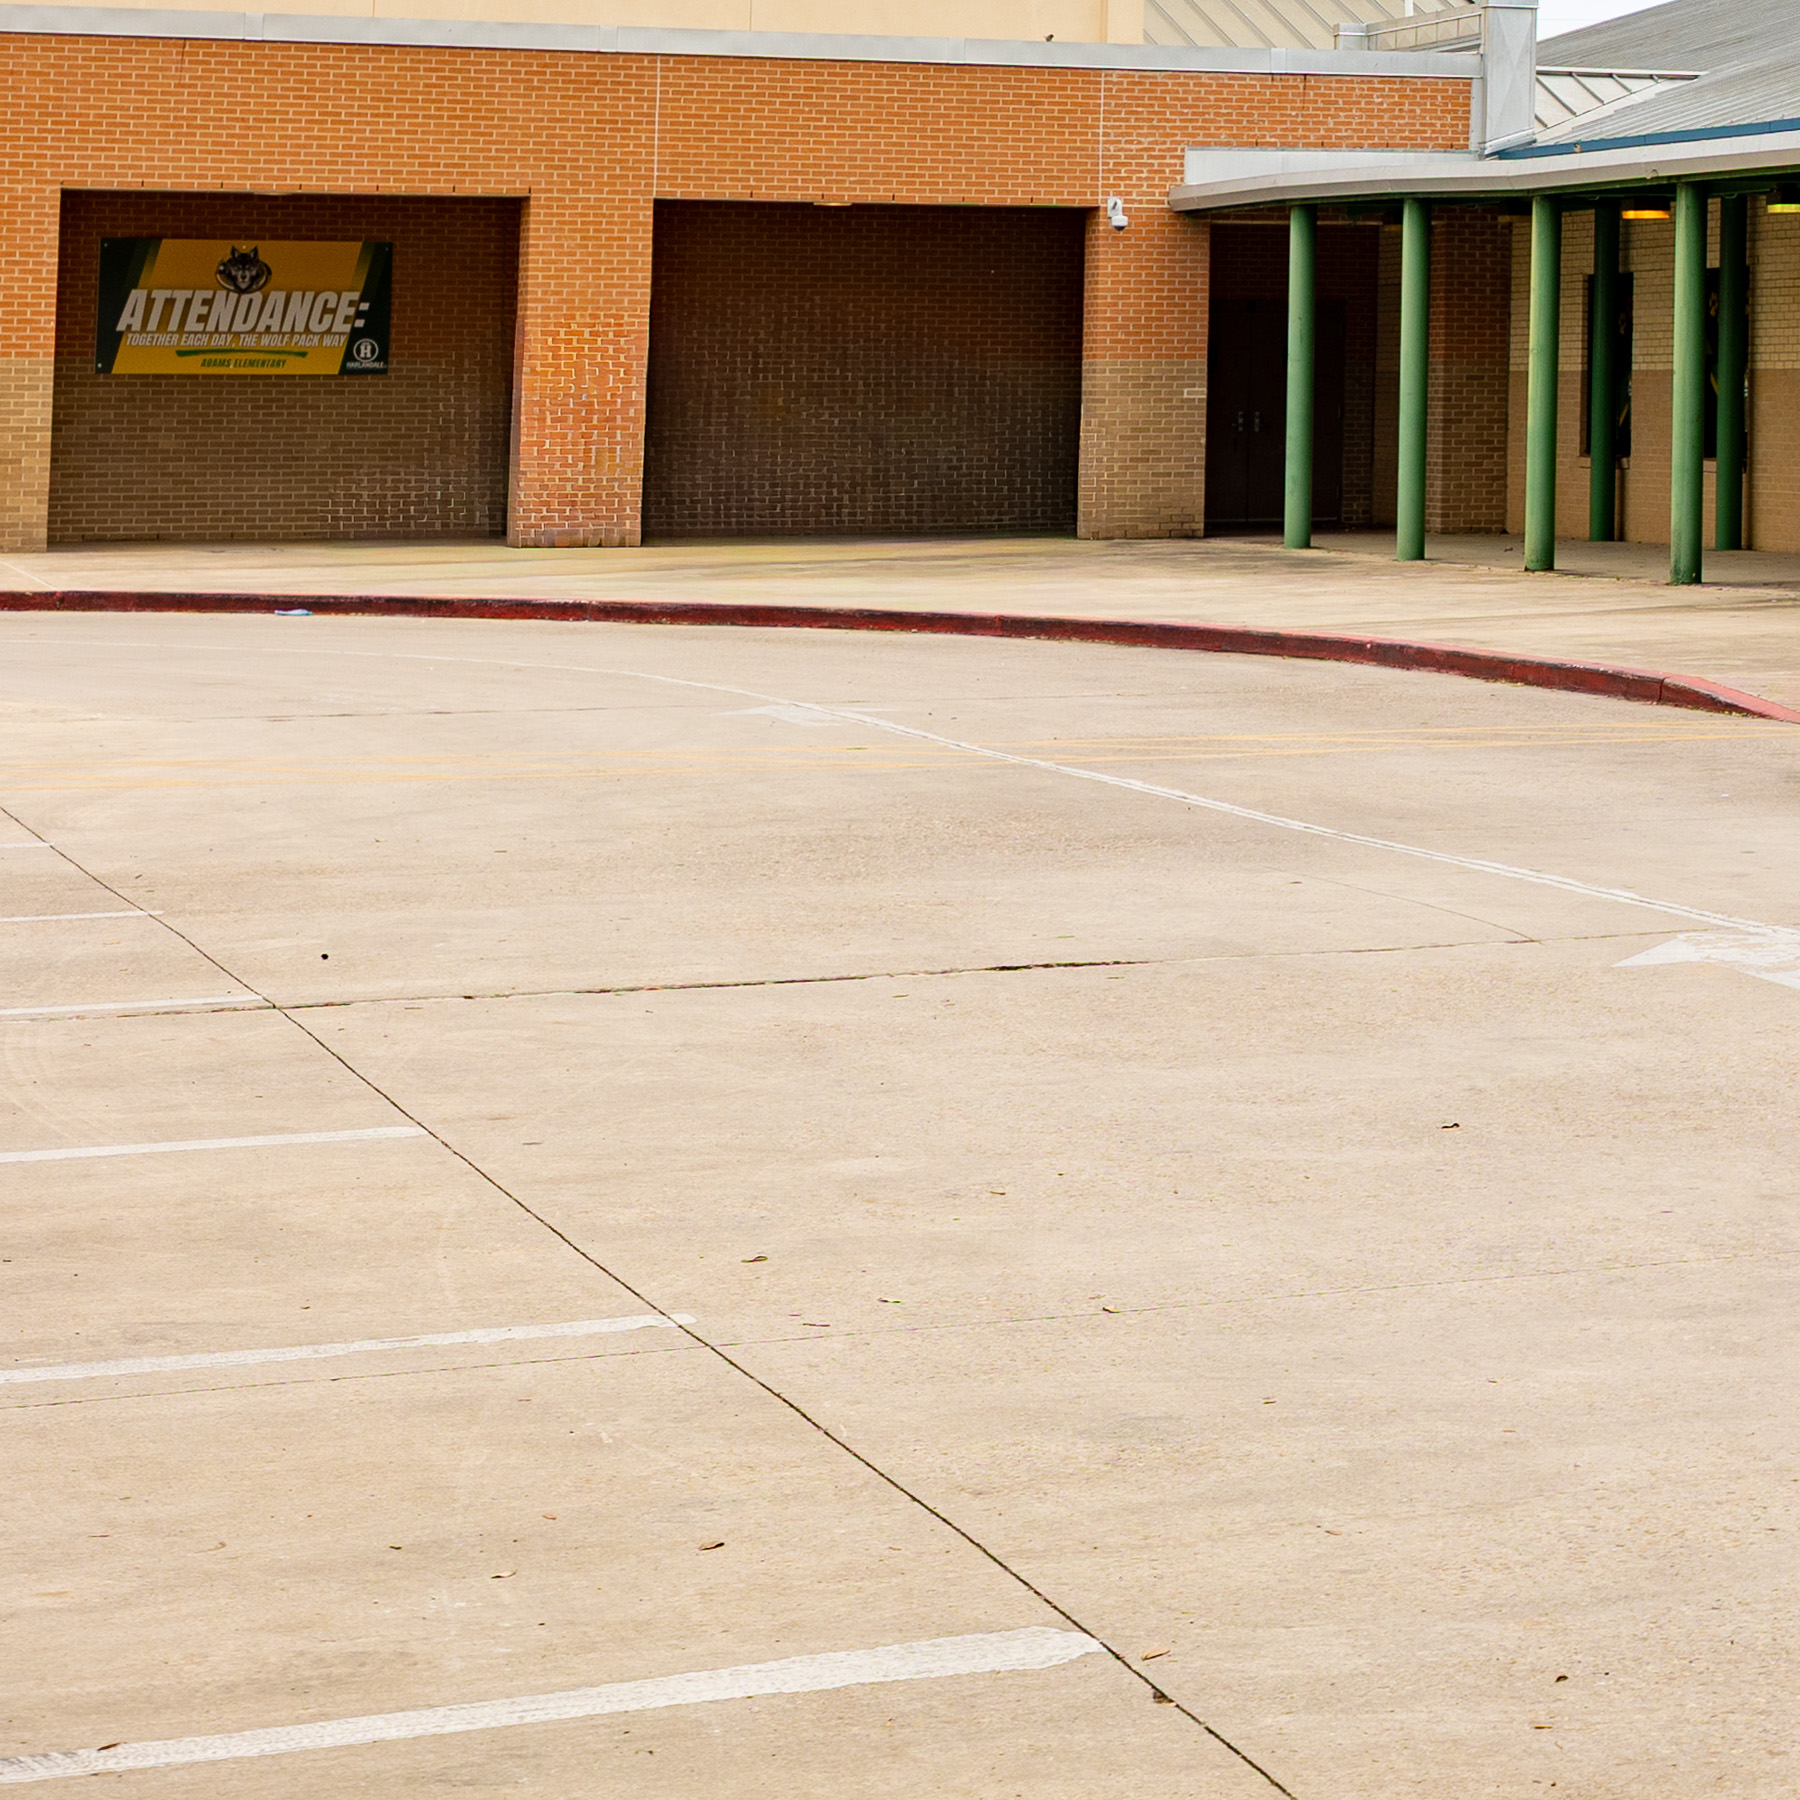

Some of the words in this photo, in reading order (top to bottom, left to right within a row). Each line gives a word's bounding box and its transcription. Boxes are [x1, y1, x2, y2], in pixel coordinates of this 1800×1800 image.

[115, 288, 371, 334] ATTENDANCE:
[126, 333, 179, 347] TOGETHER
[180, 333, 210, 347] EACH
[239, 333, 258, 347] THE
[260, 334, 290, 347] WOLF
[291, 334, 322, 347] PACK
[322, 334, 348, 347] WAY
[201, 358, 231, 368] ADAMS
[234, 358, 287, 369] ELEMENTARY
